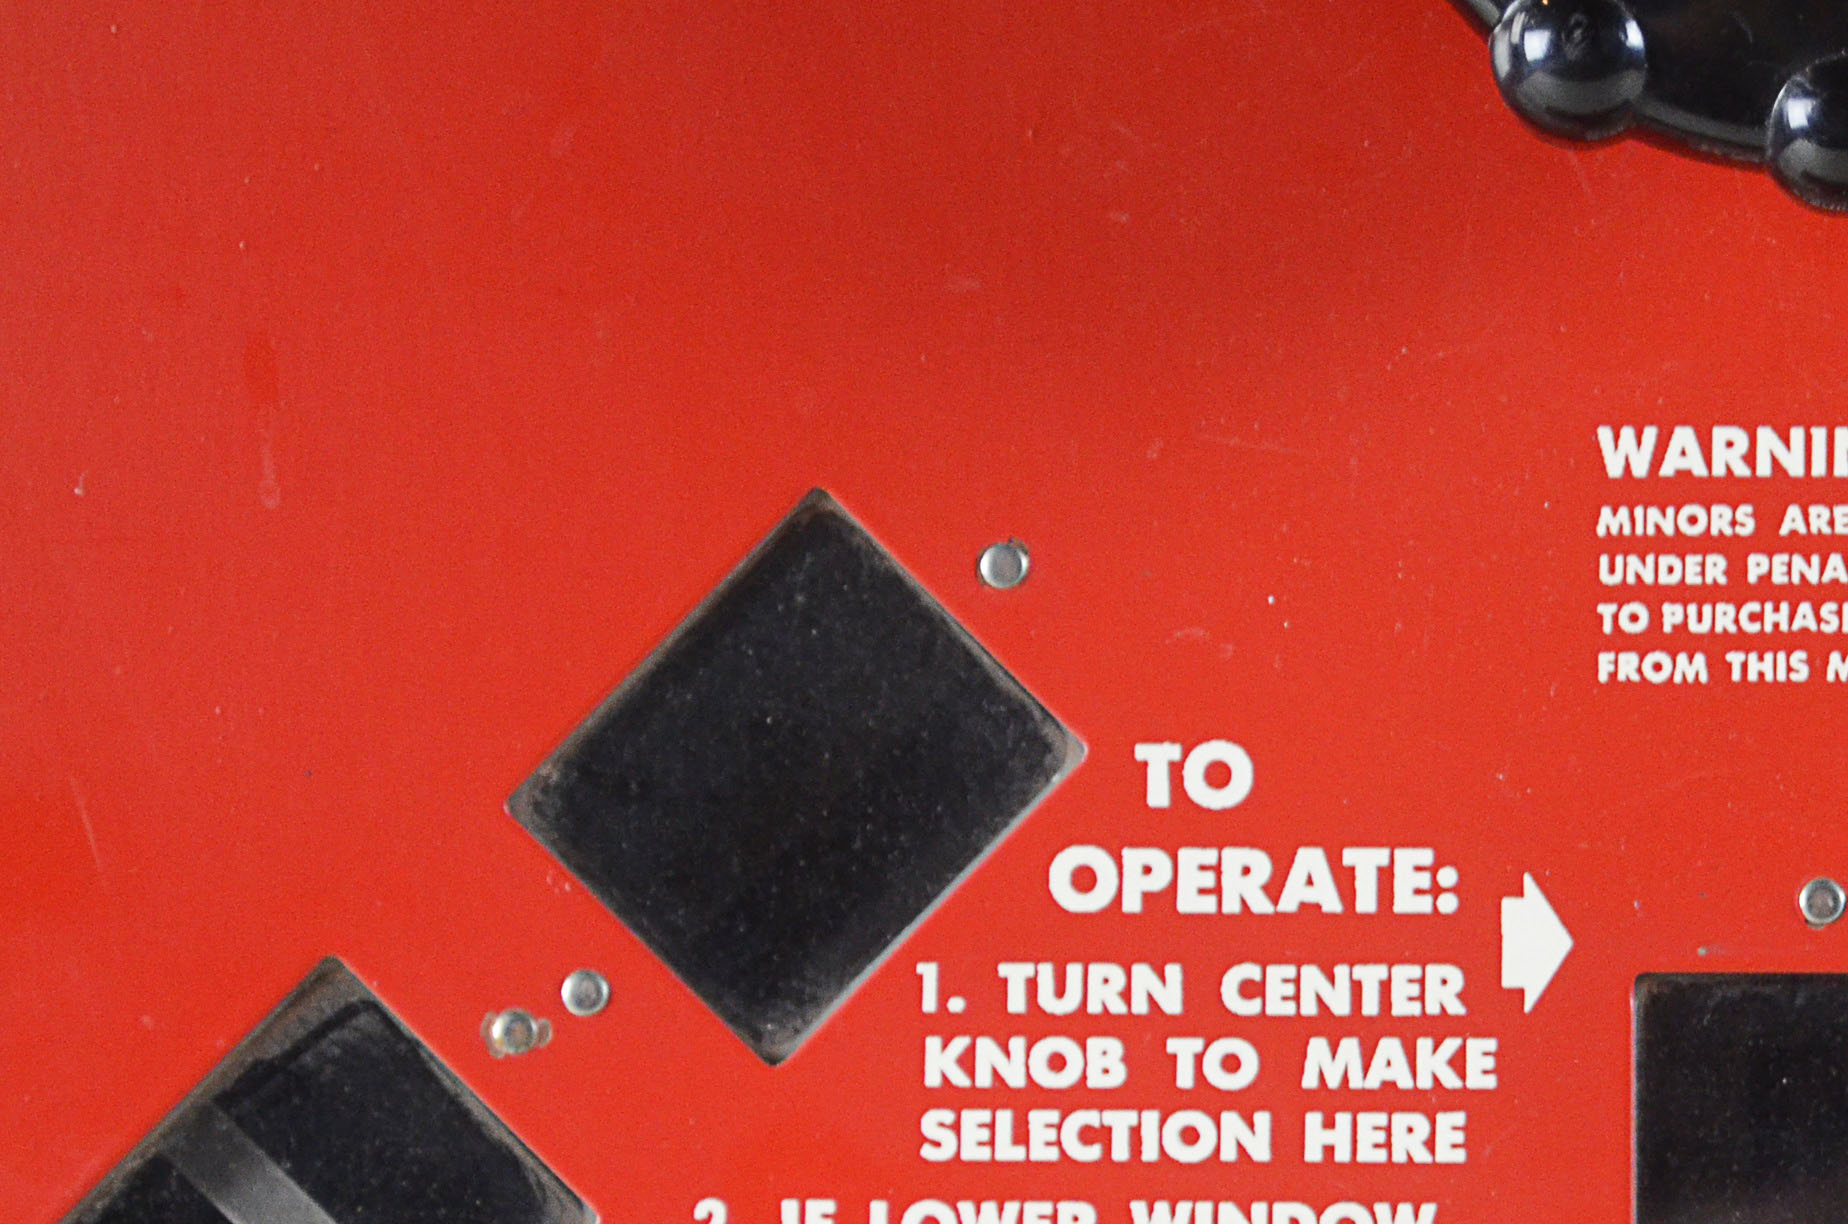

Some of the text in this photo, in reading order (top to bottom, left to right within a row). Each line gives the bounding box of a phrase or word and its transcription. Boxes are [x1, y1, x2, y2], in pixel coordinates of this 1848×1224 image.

[1596, 503, 1756, 538] MINORS
[1599, 552, 1728, 586] UNDER
[1596, 601, 1650, 635] TO
[1597, 650, 1709, 685] FROM
[1725, 650, 1810, 684] THIS
[1134, 739, 1254, 811] TO
[1048, 844, 1460, 915] OPERATE:
[915, 961, 1467, 1017] 1. TURN CENTER
[923, 1035, 1499, 1092] KNOB TO MAKE
[919, 1108, 1468, 1164] SELECTION HERE
